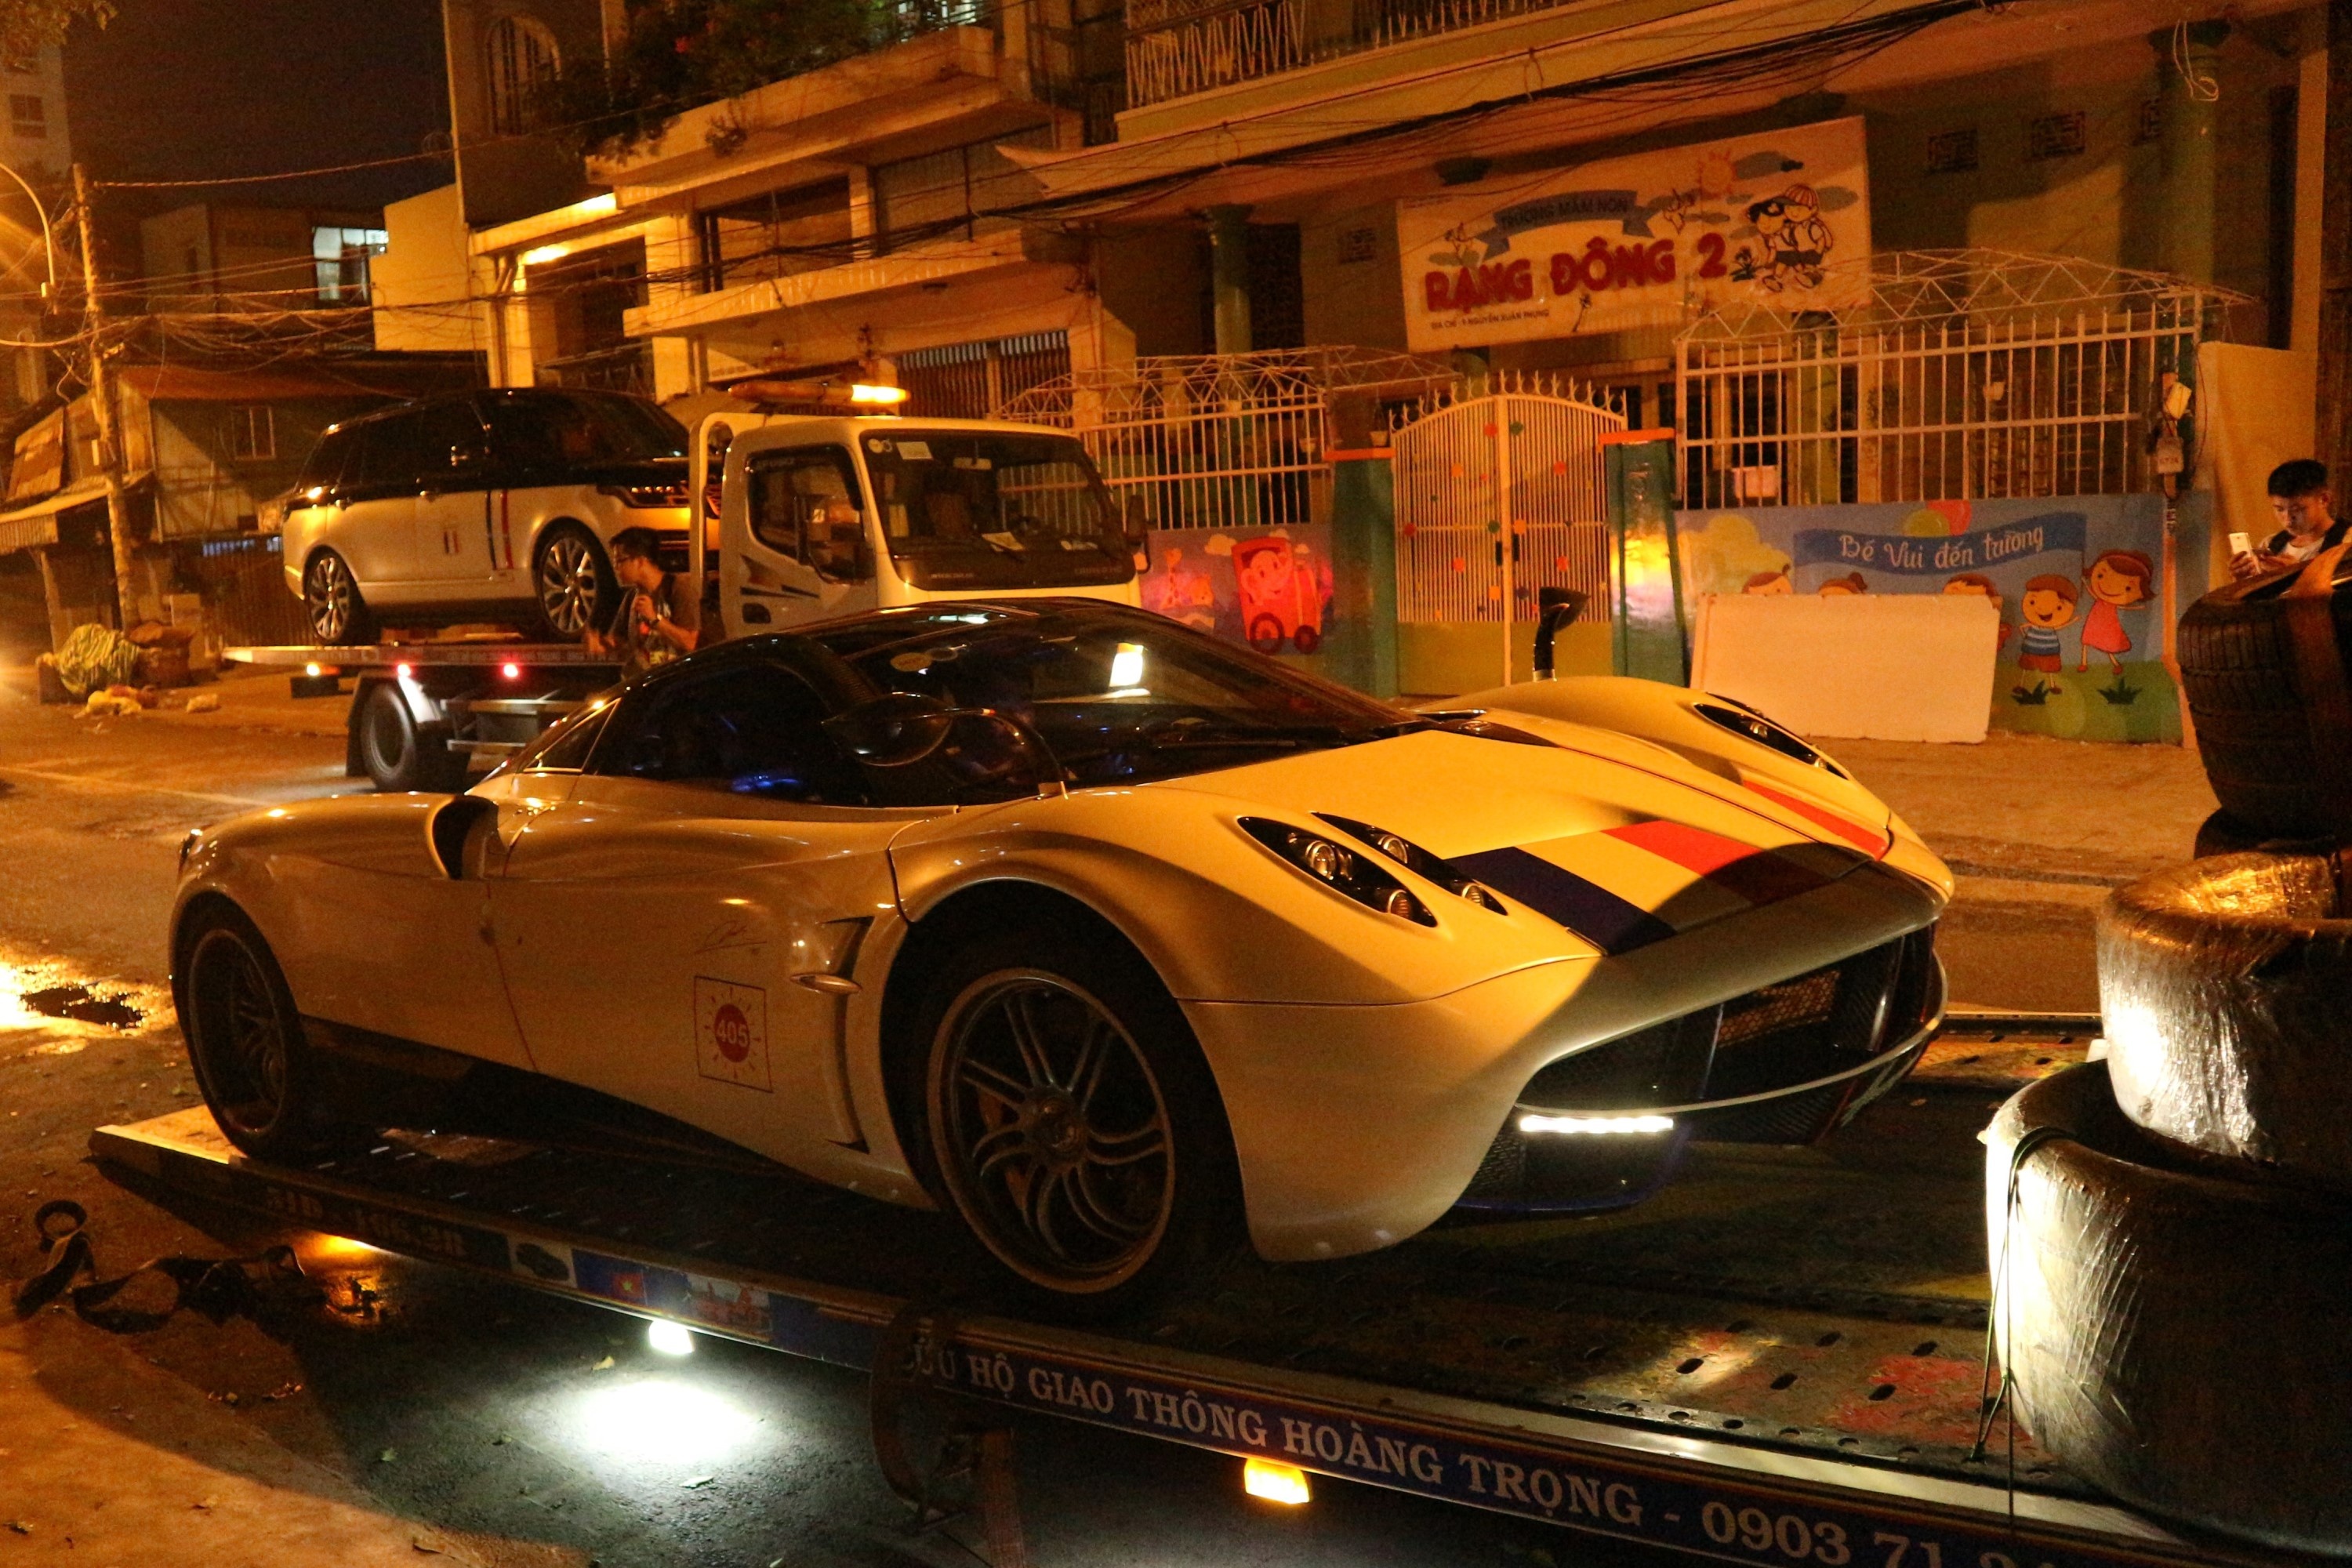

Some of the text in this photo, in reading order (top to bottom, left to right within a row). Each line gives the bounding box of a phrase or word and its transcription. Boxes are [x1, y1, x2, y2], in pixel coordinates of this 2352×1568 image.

[1550, 236, 1676, 296] ĐÔNG
[1697, 233, 1726, 278] 2
[1883, 541, 1923, 568] Vui
[716, 1018, 750, 1048] 405
[967, 1352, 1014, 1399] HỘ
[1029, 1368, 1114, 1414] GIAO
[1127, 1390, 1267, 1447] THÔNG
[1280, 1417, 1443, 1484] HOÀNG
[1459, 1454, 1643, 1525] TRỌNG
[1702, 1501, 1851, 1566] 0903
